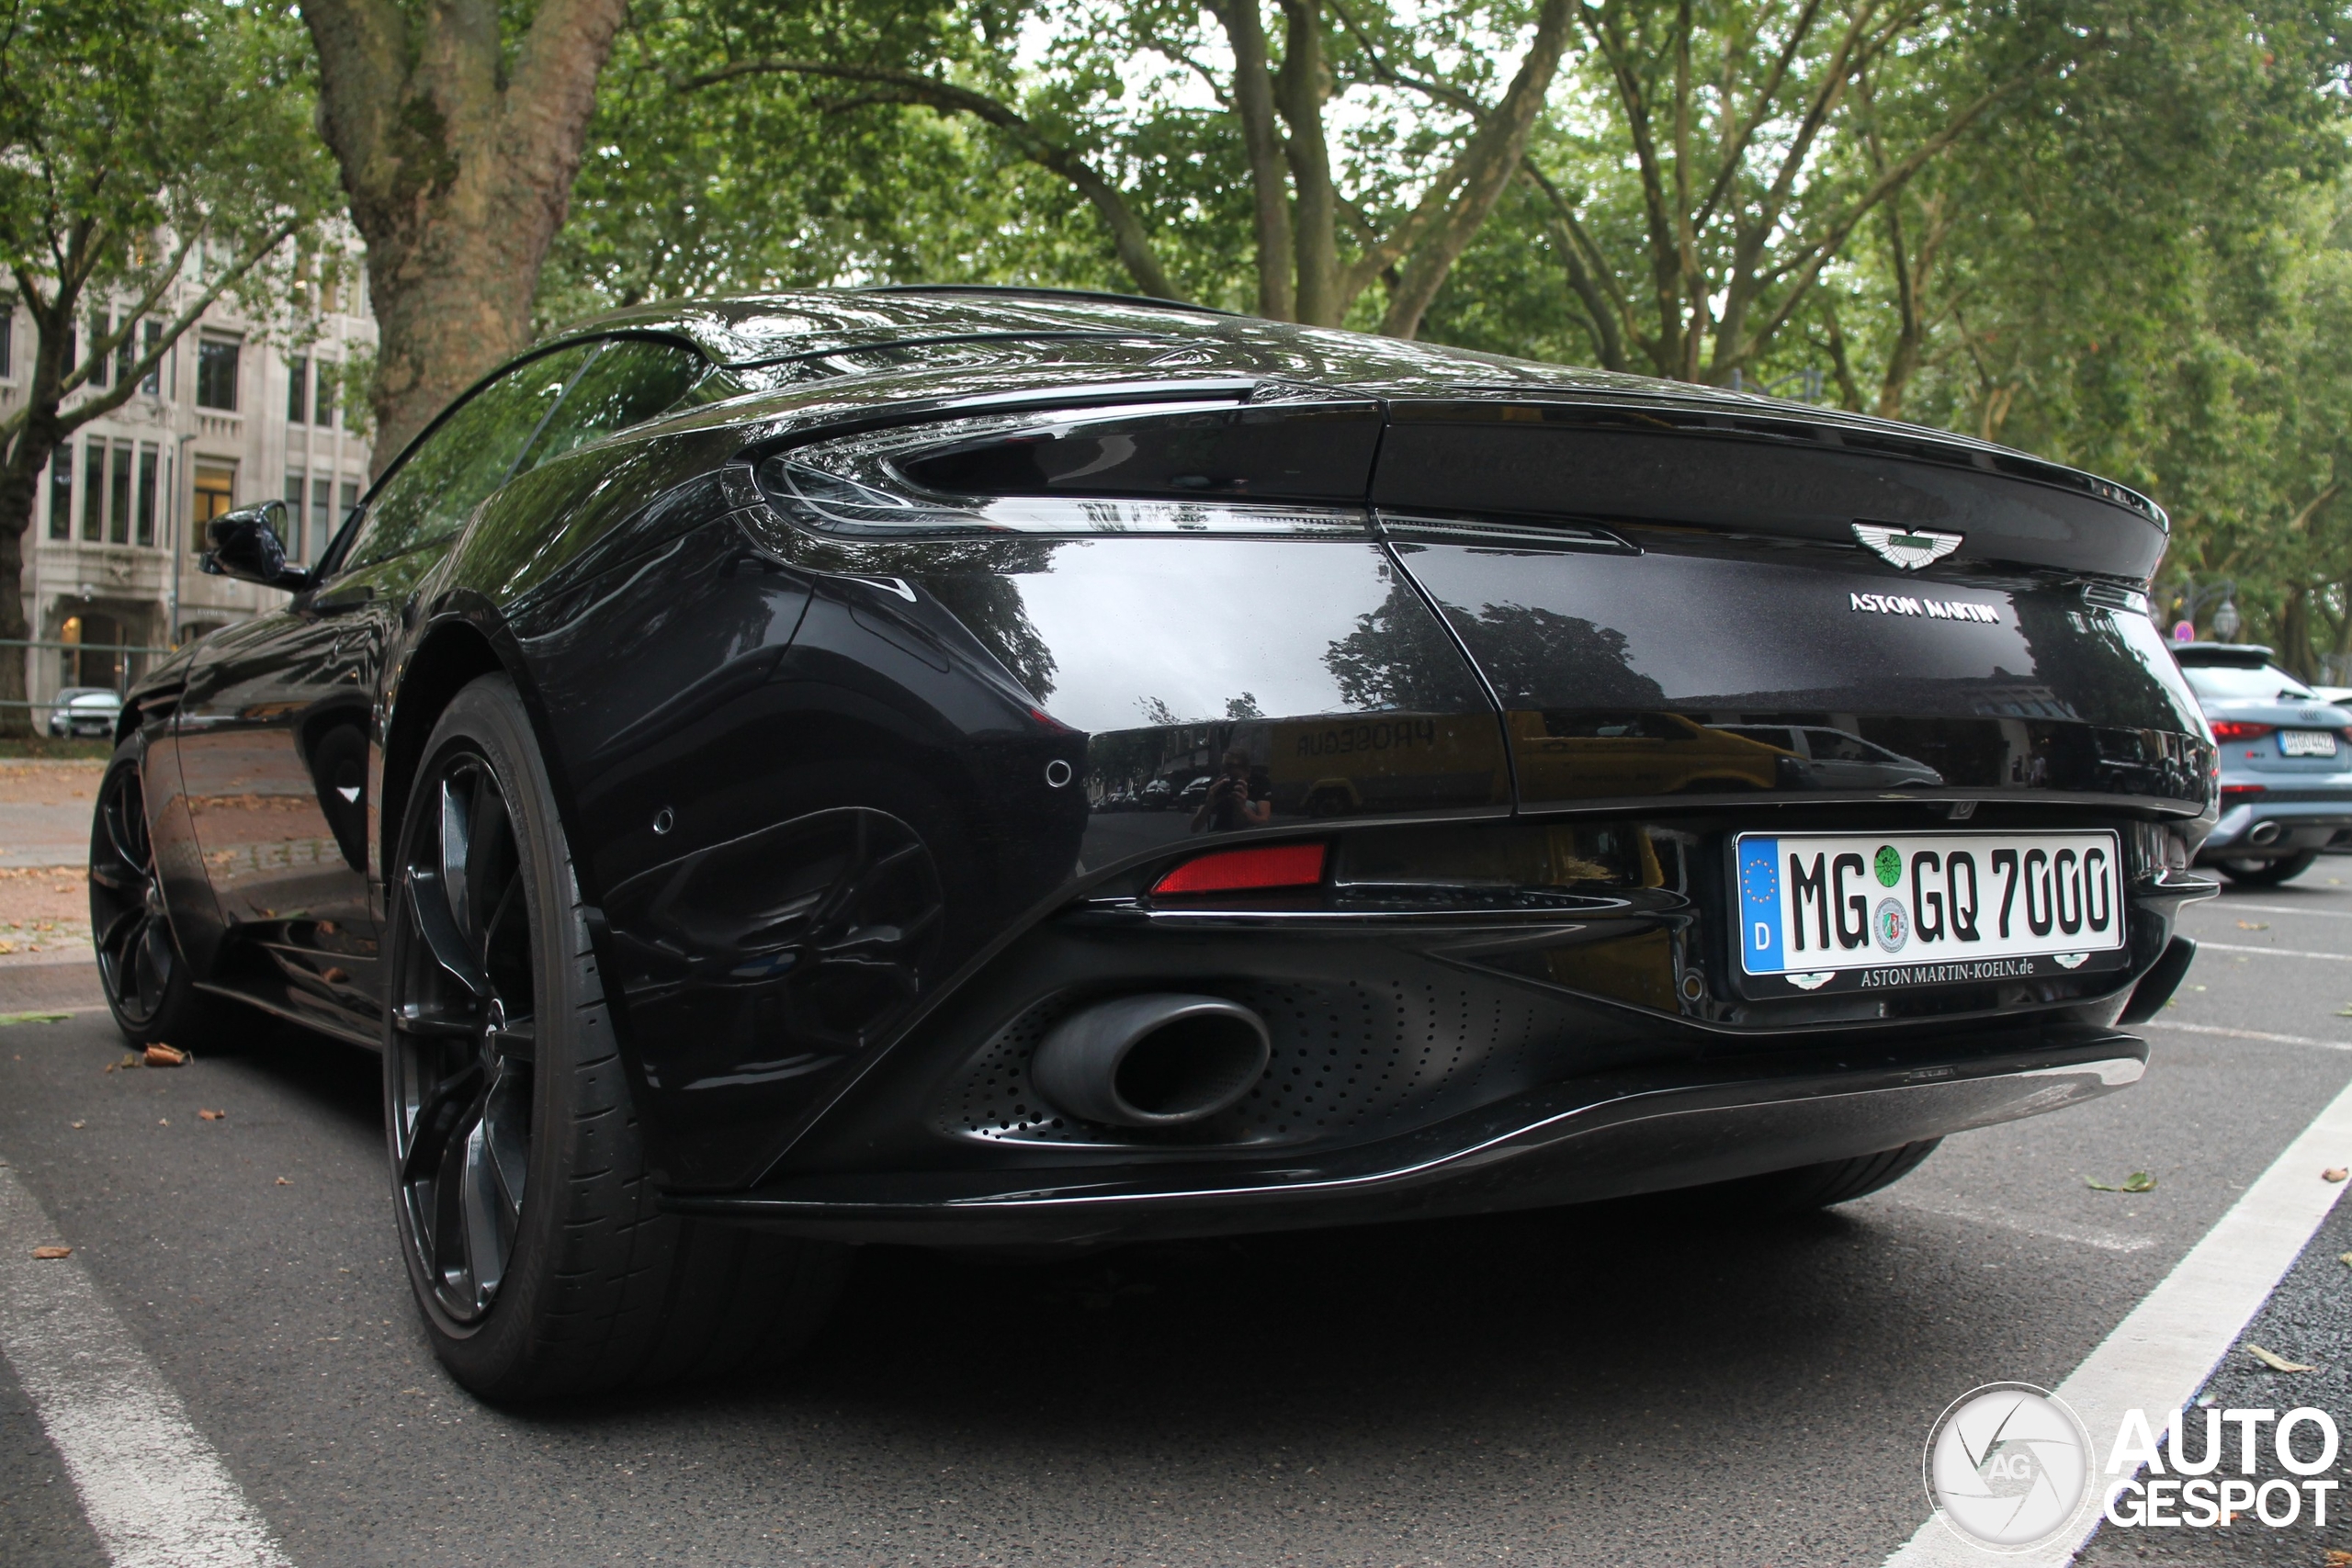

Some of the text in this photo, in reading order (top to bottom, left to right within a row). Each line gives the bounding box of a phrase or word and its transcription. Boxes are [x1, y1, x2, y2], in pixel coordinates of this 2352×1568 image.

[1849, 592, 2000, 624] ASTON MARTIN
[1789, 852, 1870, 952] MG
[1911, 851, 1981, 942] GQ
[1991, 847, 2110, 939] 7000
[1754, 922, 1770, 951] D
[1860, 960, 2034, 987] ASTON MARTIN-KOELN.de
